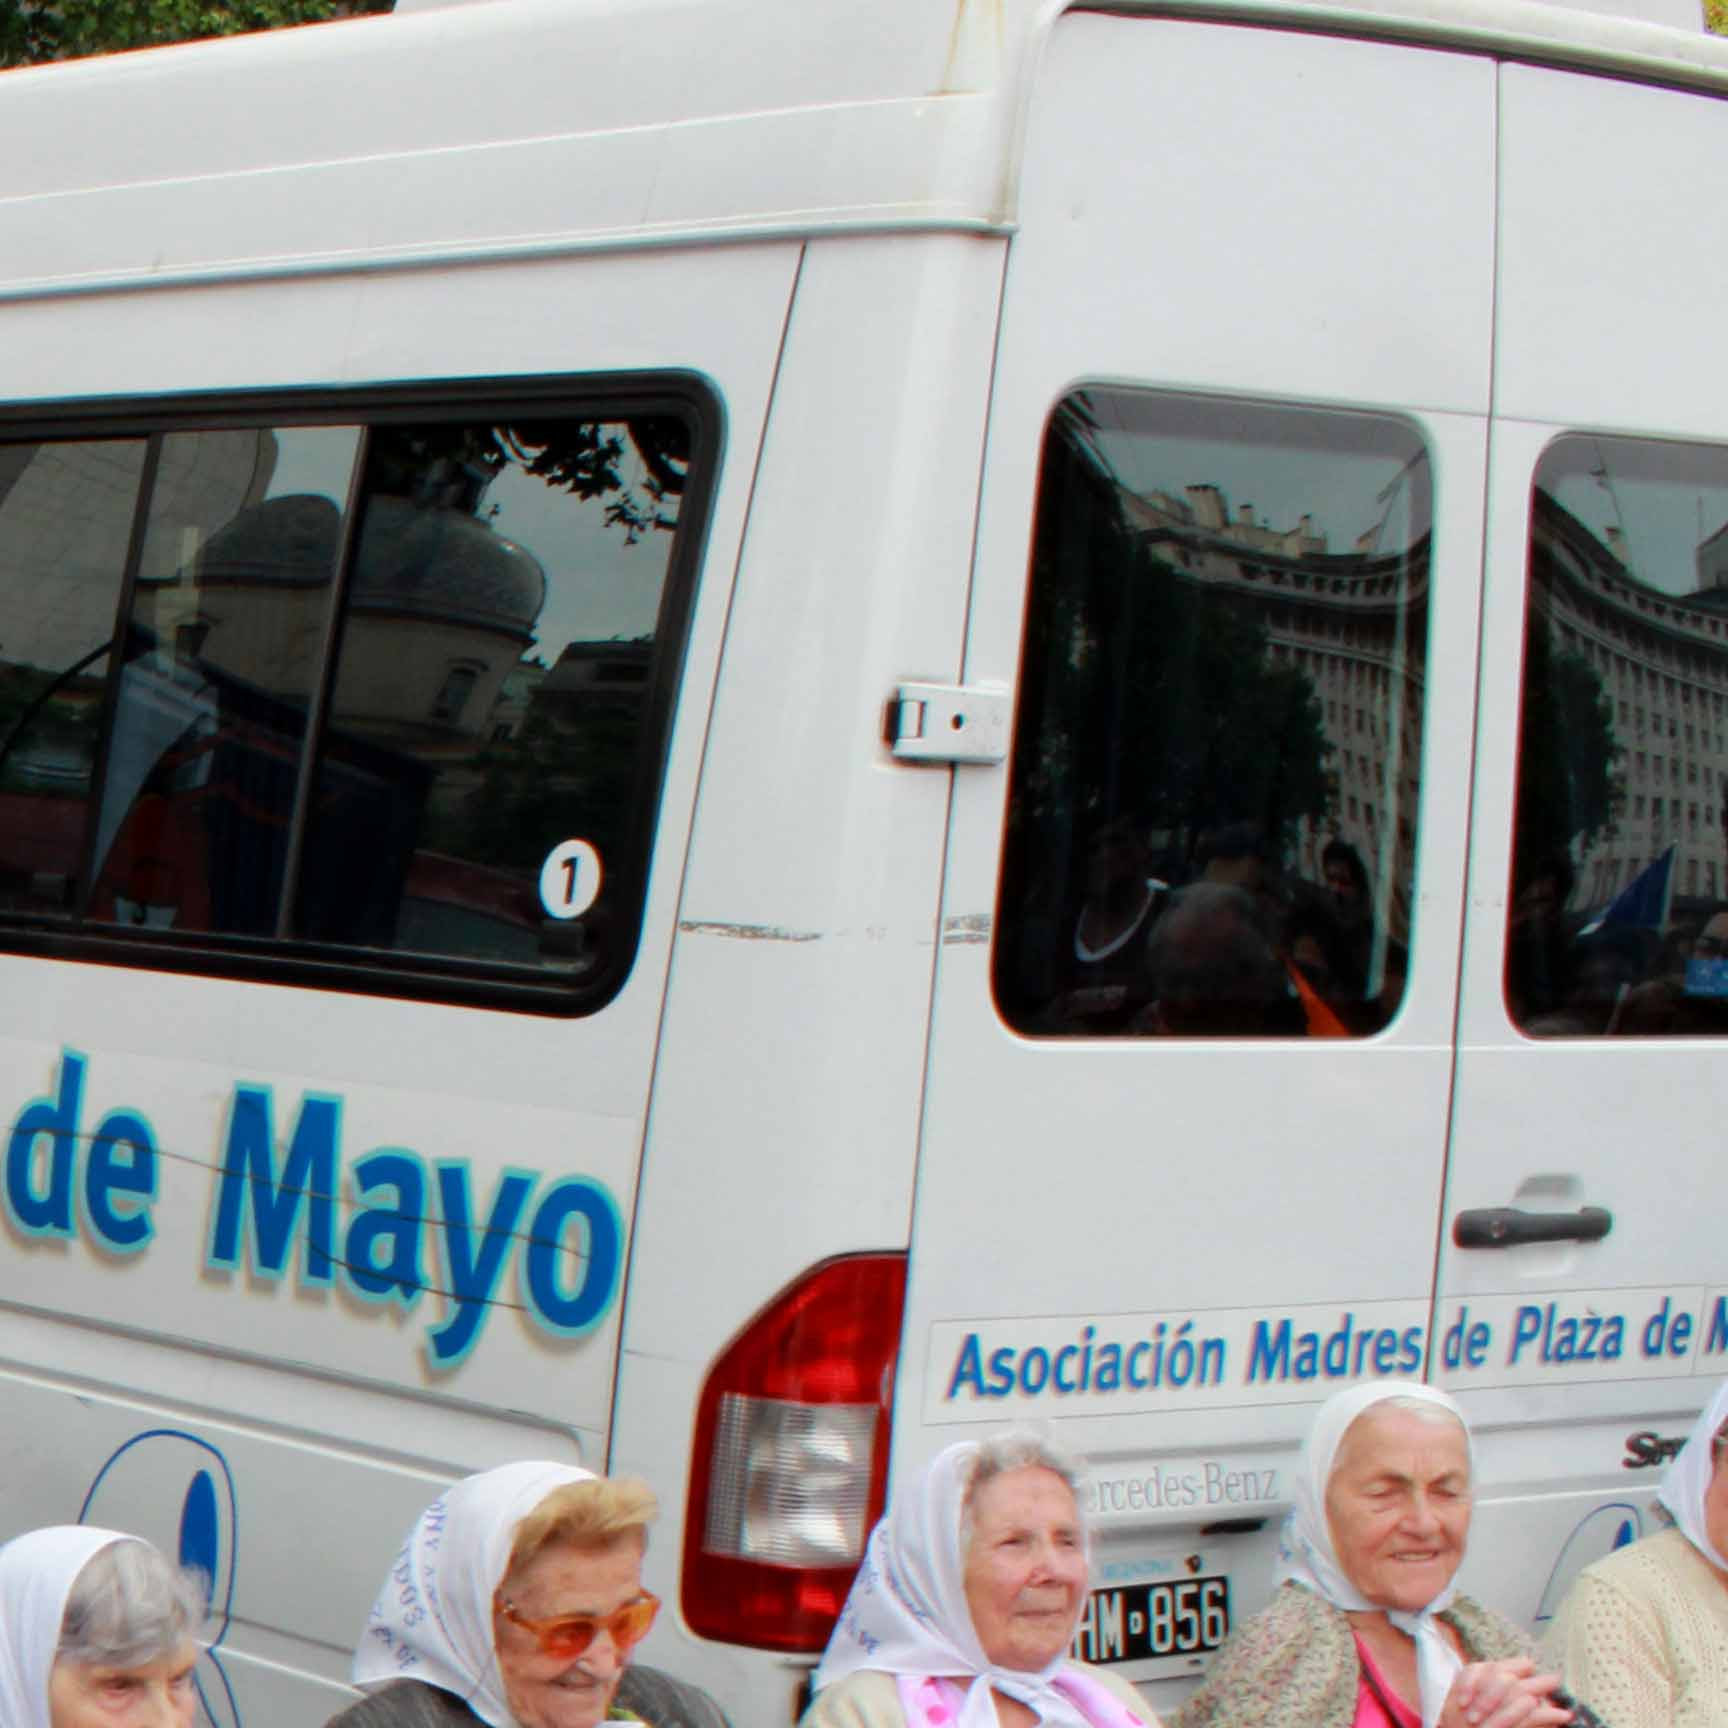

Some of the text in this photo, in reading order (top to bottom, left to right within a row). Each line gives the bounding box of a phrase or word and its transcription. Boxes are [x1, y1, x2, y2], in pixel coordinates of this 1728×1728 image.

[561, 856, 581, 905] 1
[0, 1045, 627, 1372] de Mayo
[948, 1321, 1226, 1400] Asociación
[1248, 1309, 1424, 1386] Madres
[1442, 1305, 1491, 1369] de
[1506, 1302, 1625, 1366] Plaza
[1641, 1296, 1692, 1358] de
[1087, 1462, 1278, 1513] ercedes-Benz
[1070, 1590, 1124, 1662] HM
[1149, 1580, 1227, 1654] 856
